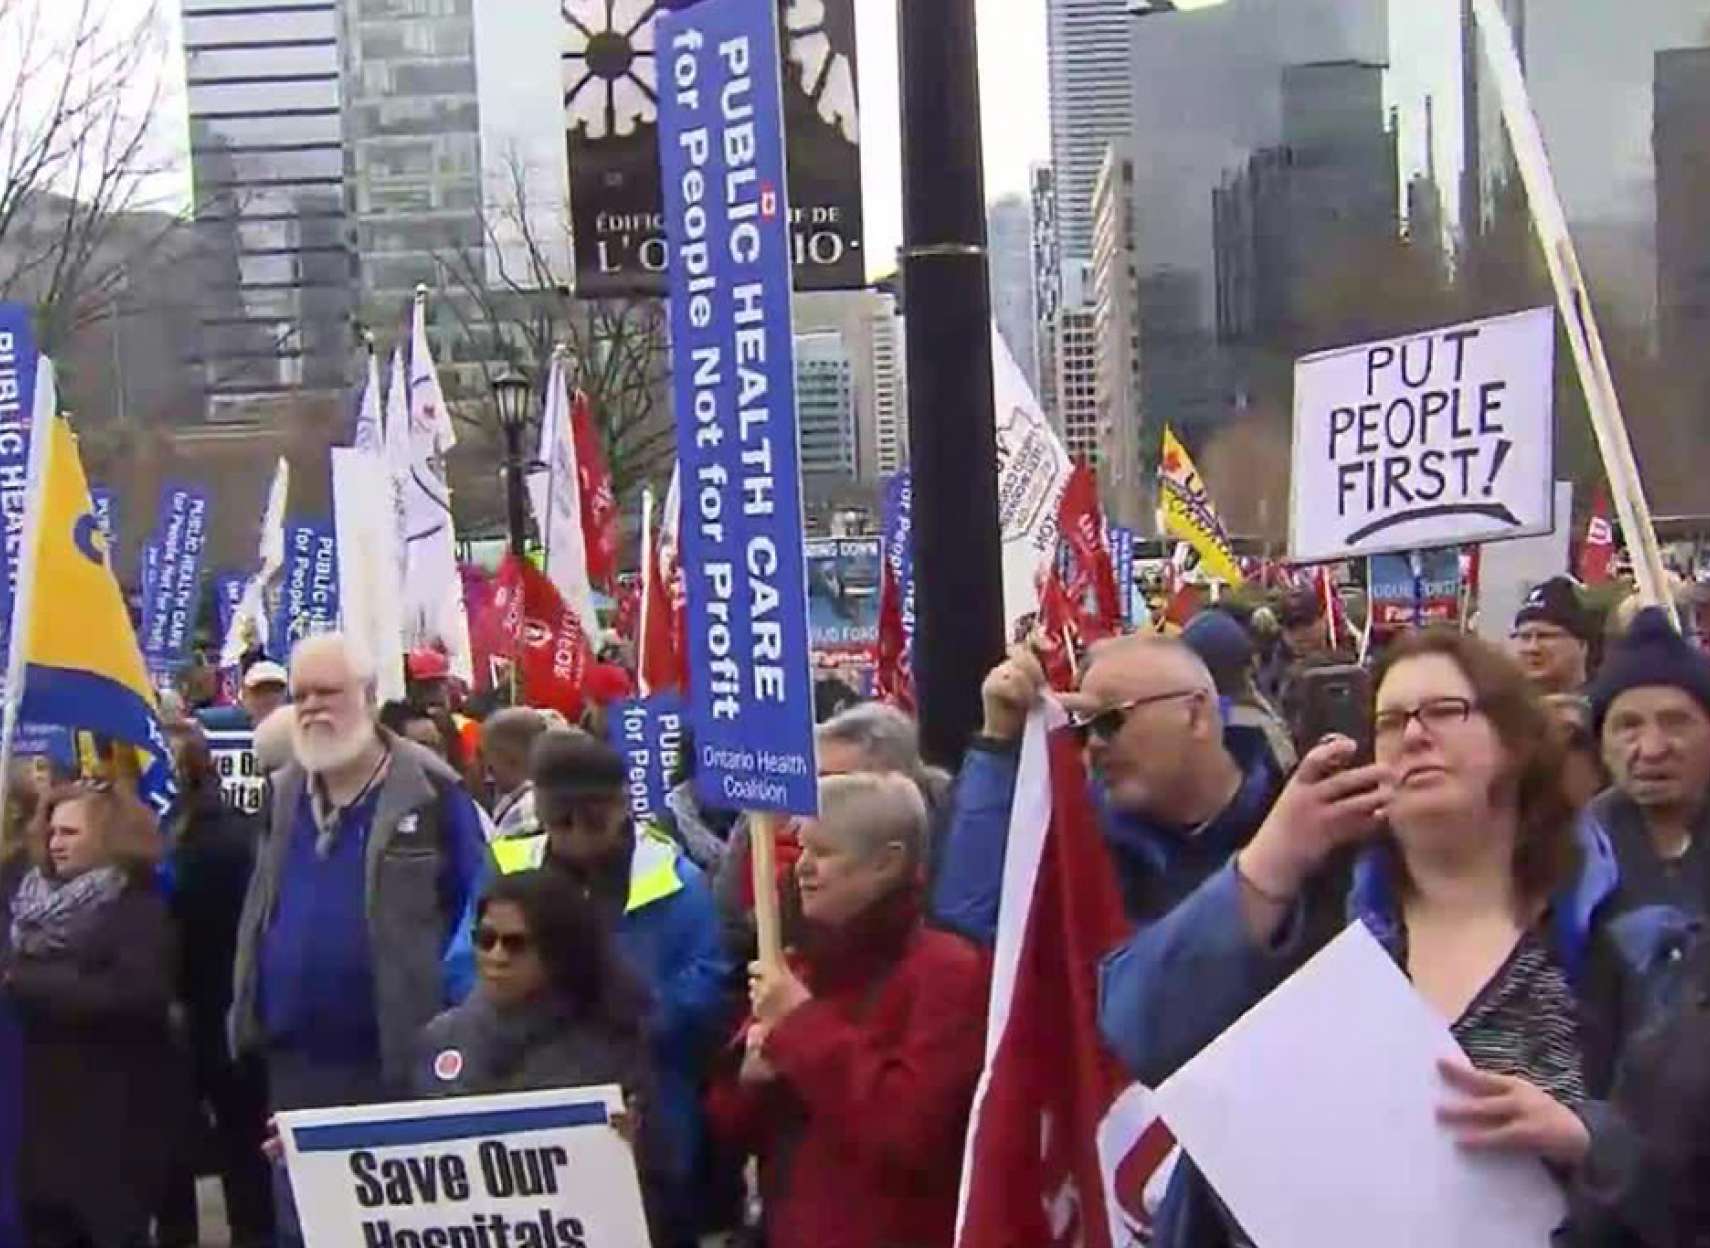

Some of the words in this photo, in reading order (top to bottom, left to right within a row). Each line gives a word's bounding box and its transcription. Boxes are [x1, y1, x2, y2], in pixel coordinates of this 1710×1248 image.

[672, 27, 703, 111] for
[719, 35, 761, 264] PUBLIC
[595, 210, 665, 233] ÉDIFIC
[812, 207, 840, 222] DE
[679, 127, 717, 328] People
[690, 346, 725, 449] Not
[732, 283, 775, 515] HEALTH
[1366, 328, 1481, 396] PUT
[1327, 380, 1507, 460] PEOPLE
[698, 463, 728, 544] for
[1337, 439, 1513, 516] FIRST!
[312, 536, 334, 603] PUBLIC
[703, 562, 741, 721] Profit
[746, 536, 786, 703] CARE
[627, 748, 657, 823] Peopl
[703, 746, 755, 770] Ontario
[756, 750, 808, 774] Health
[722, 775, 788, 804] Coalition
[349, 1150, 470, 1208] Save
[478, 1140, 568, 1199] Our
[361, 1207, 585, 1248] Hospitals
